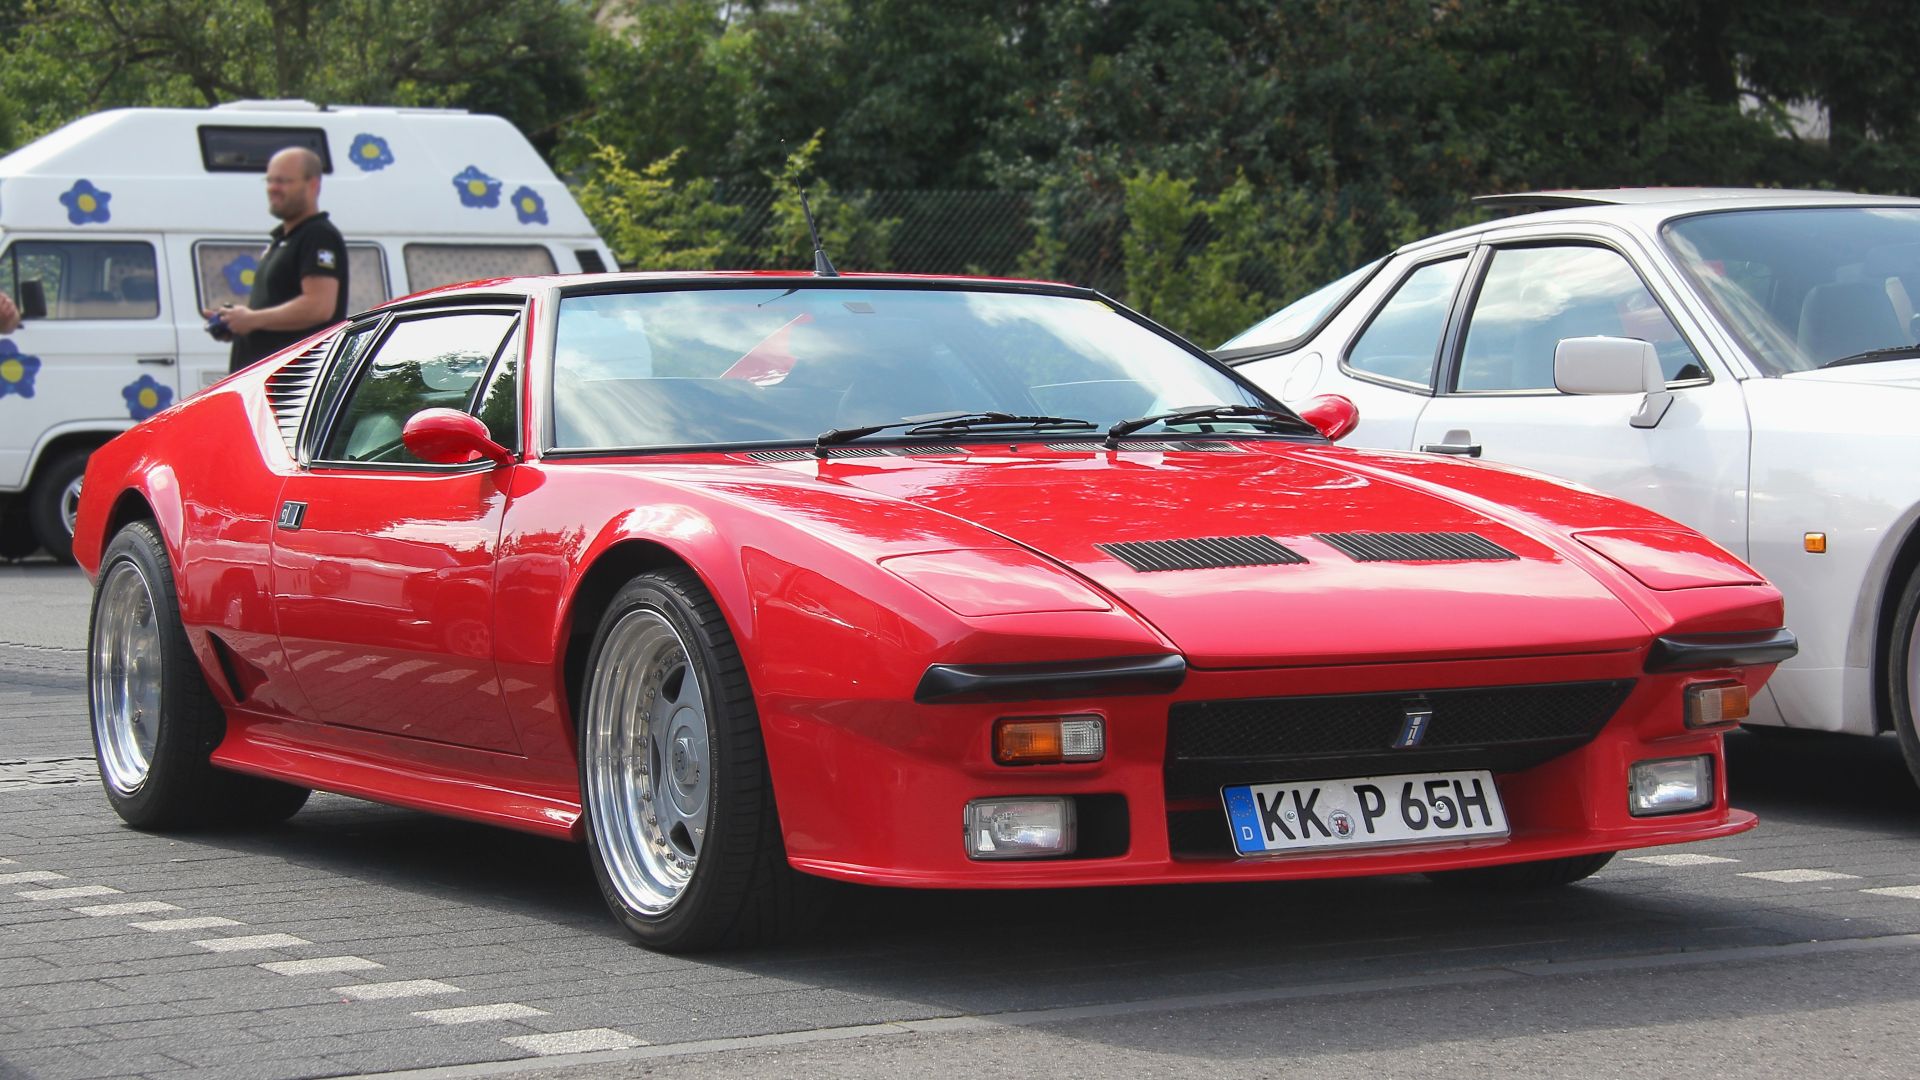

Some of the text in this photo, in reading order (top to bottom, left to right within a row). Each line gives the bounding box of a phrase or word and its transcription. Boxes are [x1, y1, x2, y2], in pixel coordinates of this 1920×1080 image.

[1256, 778, 1493, 842] KK P 65H
[1241, 825, 1254, 841] D
